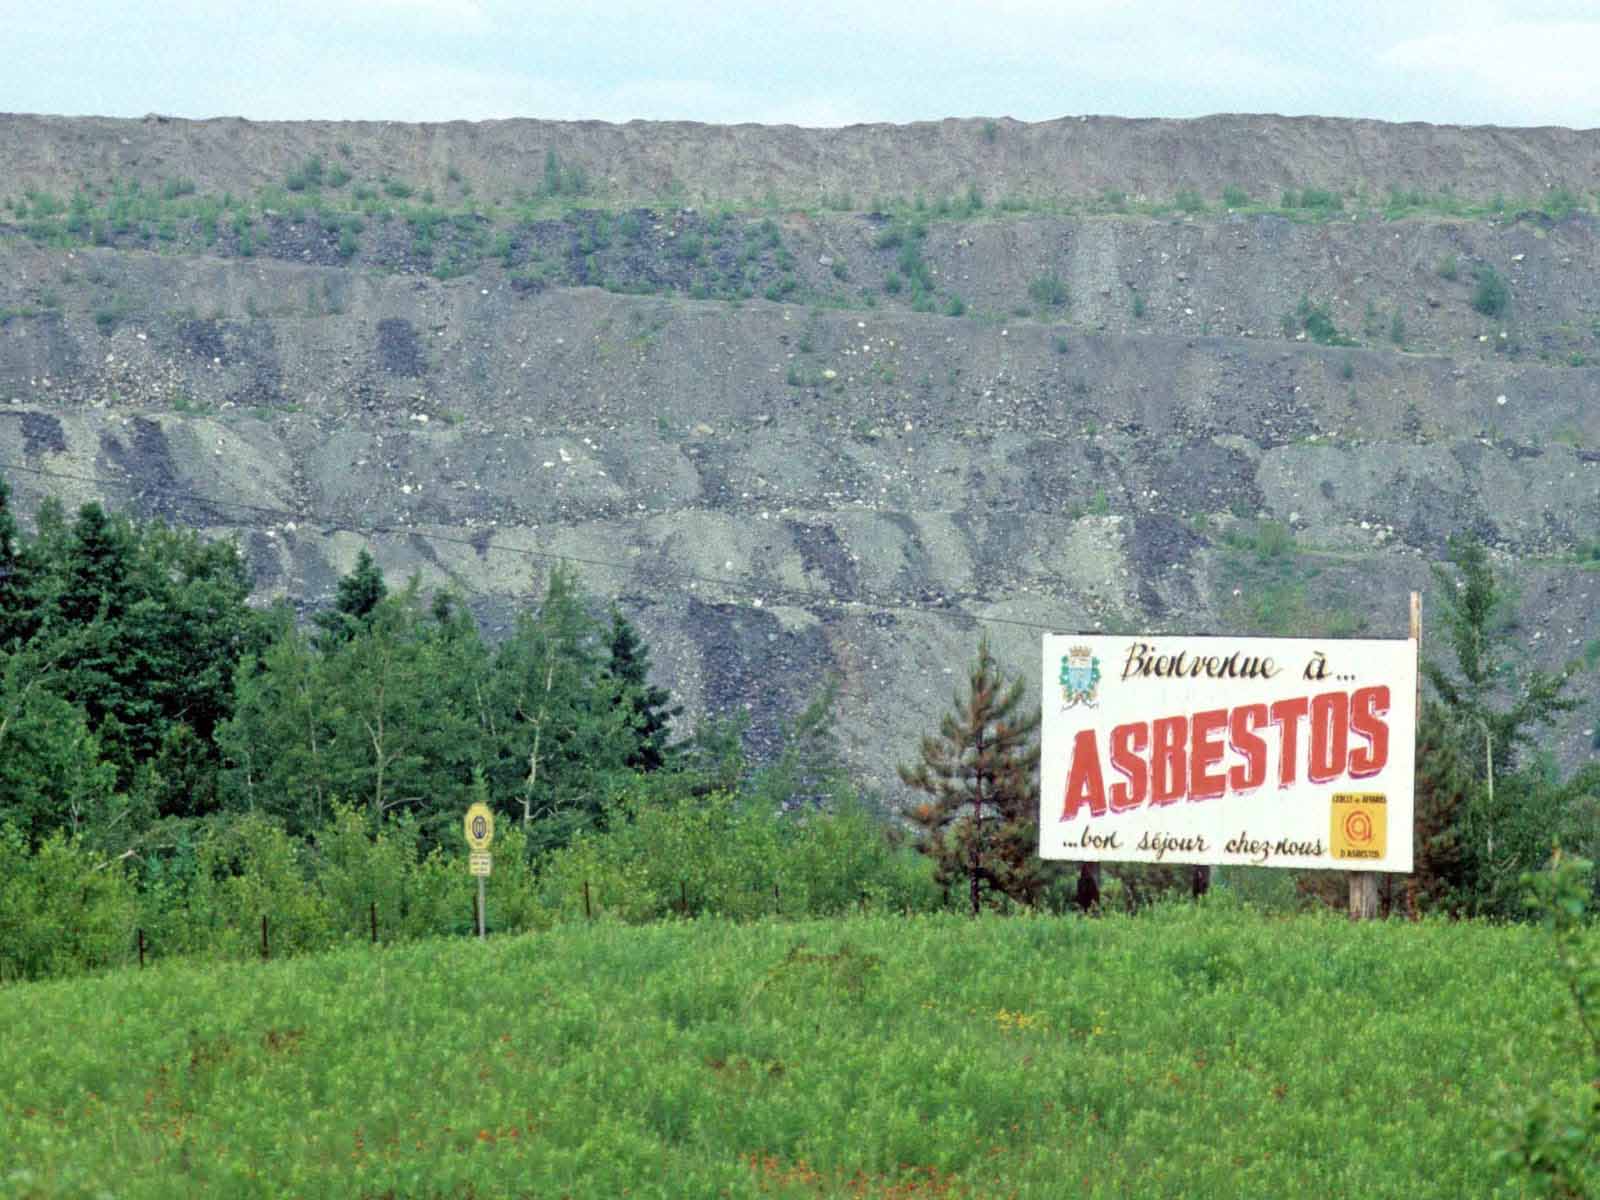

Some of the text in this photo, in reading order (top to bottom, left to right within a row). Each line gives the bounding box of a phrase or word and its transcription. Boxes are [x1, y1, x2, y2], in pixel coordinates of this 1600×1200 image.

[1120, 641, 1281, 682] Bienvenue
[1059, 684, 1391, 822] ASBESTOS
[1136, 829, 1211, 861] séjour
